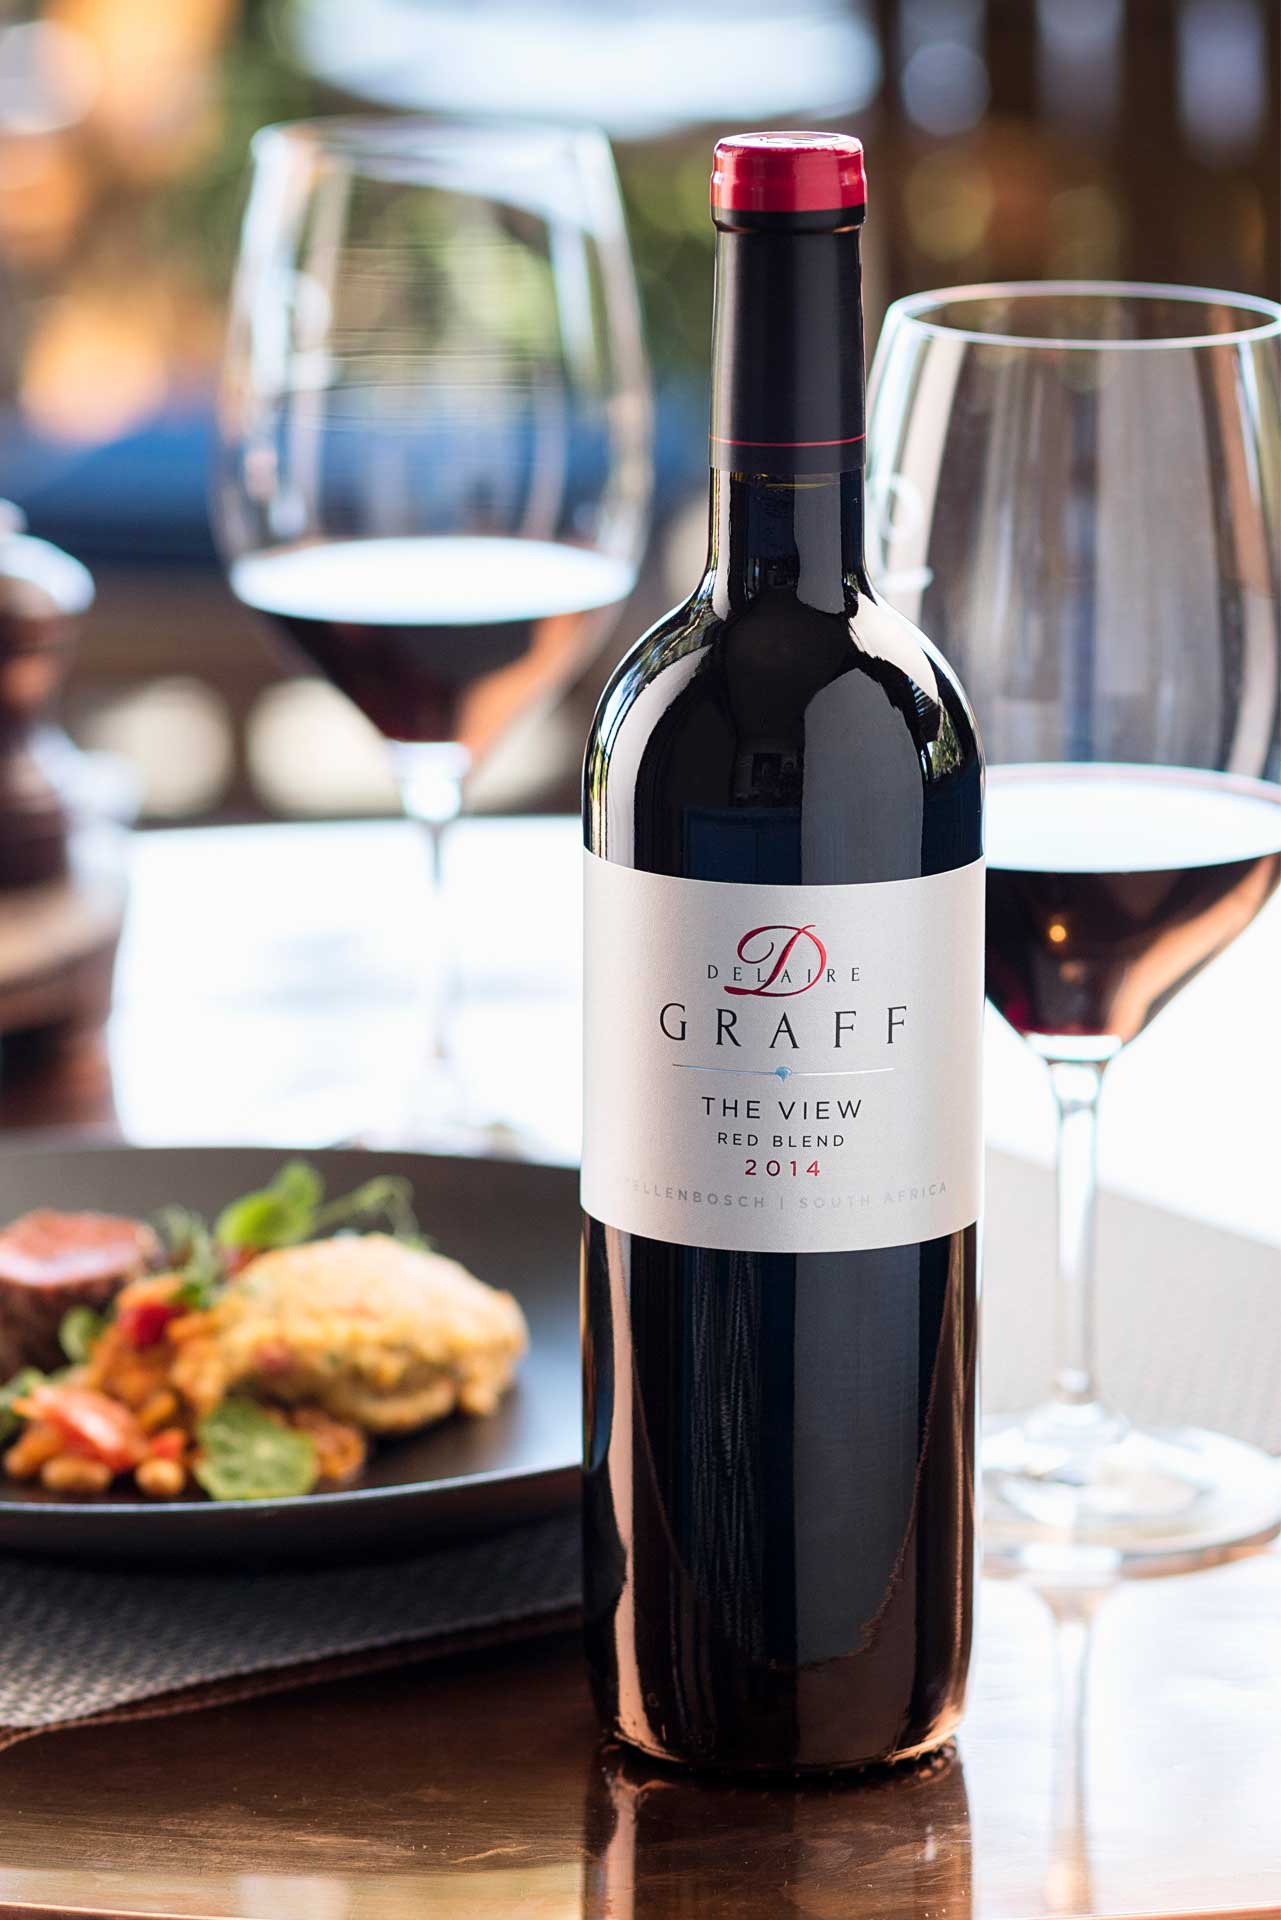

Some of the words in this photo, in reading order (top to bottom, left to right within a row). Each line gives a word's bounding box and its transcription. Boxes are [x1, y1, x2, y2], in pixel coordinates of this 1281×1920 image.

[707, 964, 861, 984] DELAIRE
[659, 1002, 907, 1049] GRAFF
[701, 1096, 761, 1119] THE
[778, 1099, 862, 1120] VIEW
[717, 1132, 759, 1147] RED
[772, 1135, 845, 1148] BLEND
[744, 1159, 821, 1177] 2014
[799, 1194, 870, 1209] SOUTH
[883, 1182, 948, 1205] AFRICA
